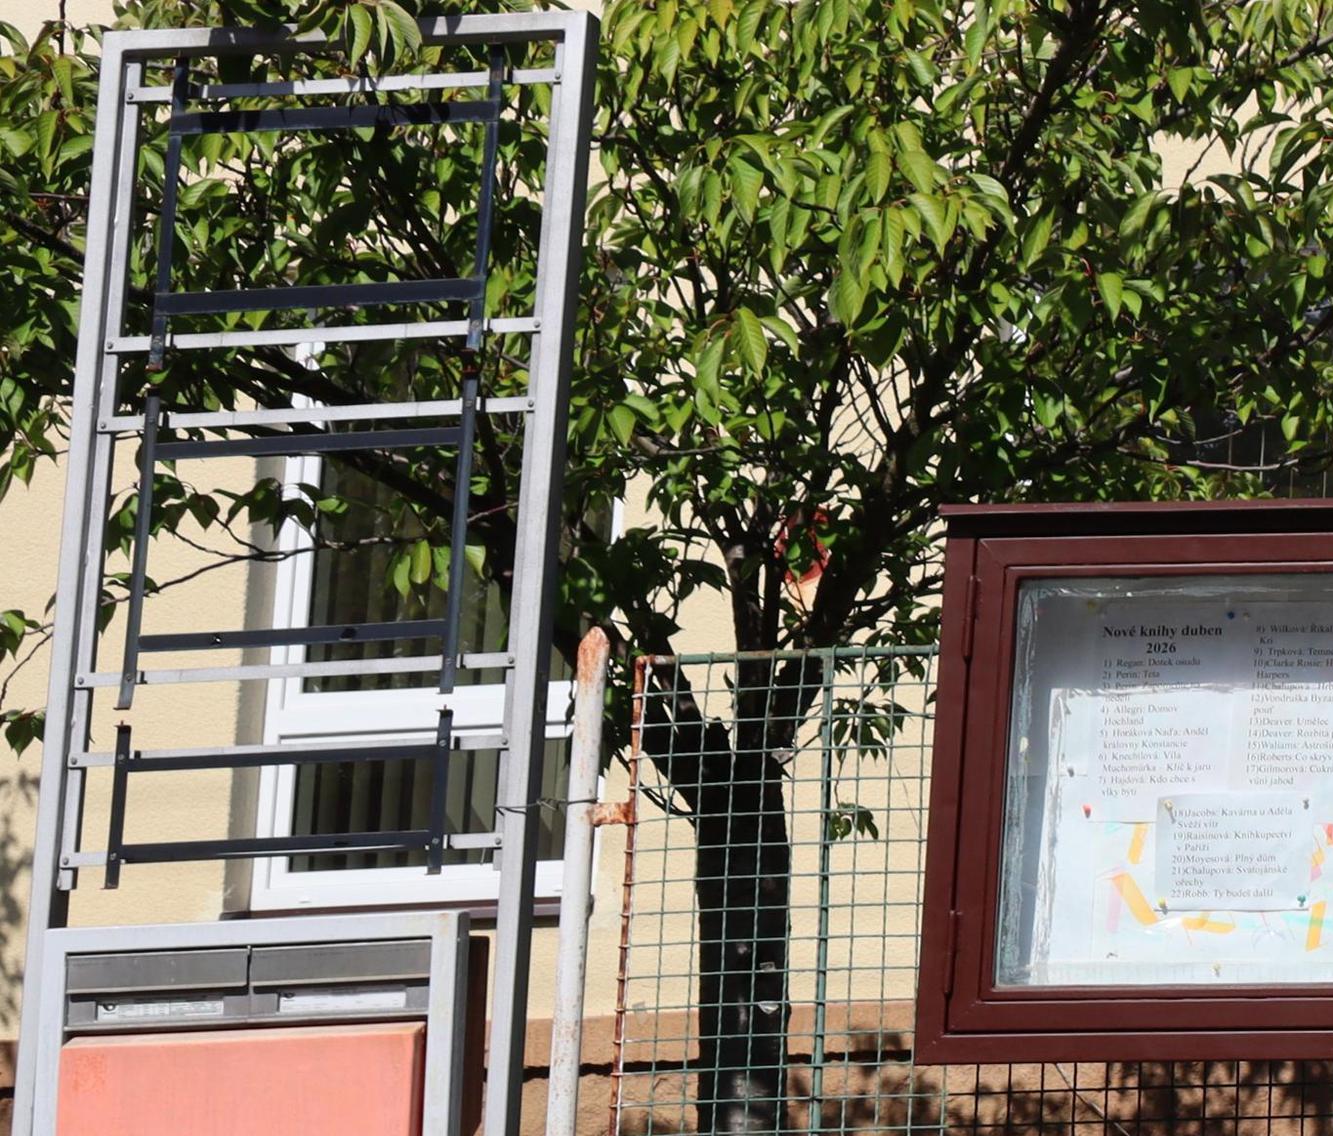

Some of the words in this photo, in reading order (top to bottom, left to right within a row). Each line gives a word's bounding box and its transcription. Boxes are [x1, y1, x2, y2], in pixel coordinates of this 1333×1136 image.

[1103, 625, 1136, 638] Nové
[1140, 625, 1177, 640] knihy
[1182, 624, 1222, 636] duben
[1146, 643, 1176, 654] 2026
[1149, 775, 1166, 784] Kdo
